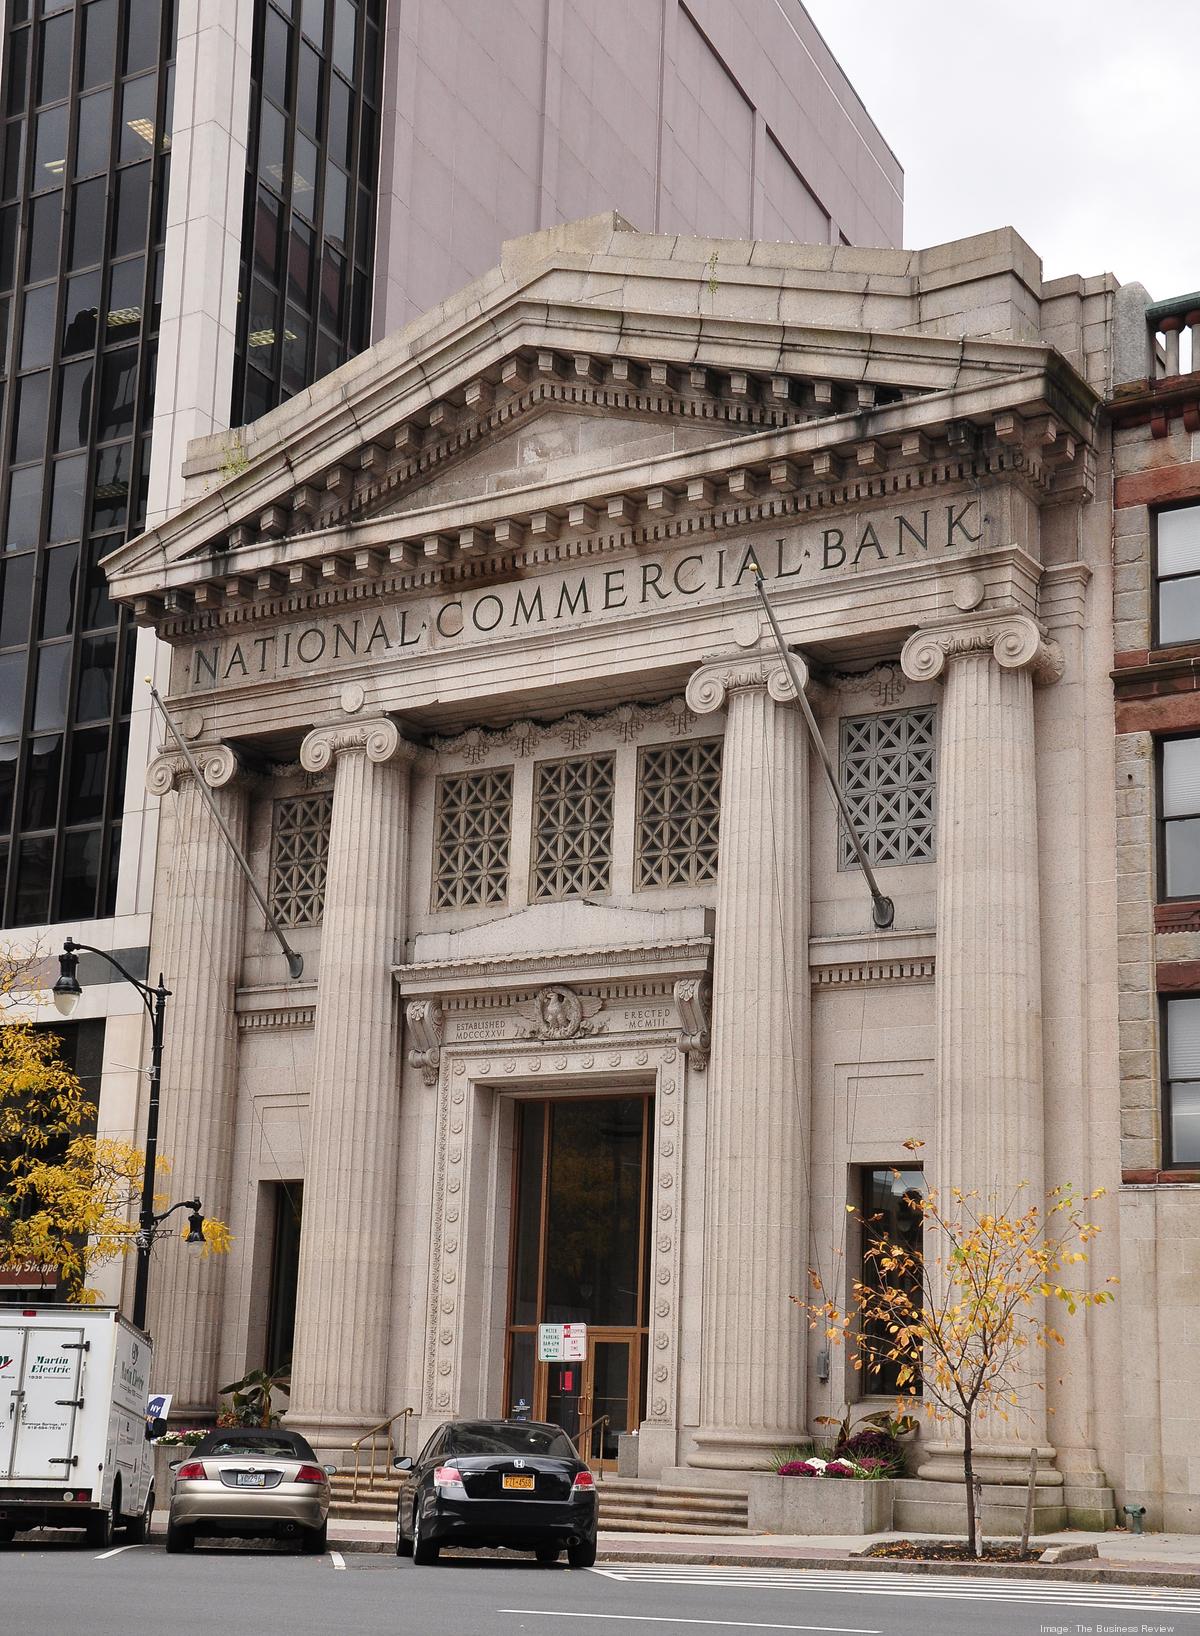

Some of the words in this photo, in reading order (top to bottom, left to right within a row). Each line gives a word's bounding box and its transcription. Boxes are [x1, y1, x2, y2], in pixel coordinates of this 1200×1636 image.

[194, 610, 421, 684] NATIONAL
[436, 538, 803, 638] COMMERCIAL
[820, 500, 983, 570] BANK
[624, 1008, 671, 1020] ERECTED
[456, 1020, 506, 1031] ESTABLISHED
[455, 1030, 505, 1040] MDCCCXXVI
[35, 1355, 69, 1365] Martin
[31, 1365, 71, 1374] Electric
[150, 1403, 161, 1413] NY
